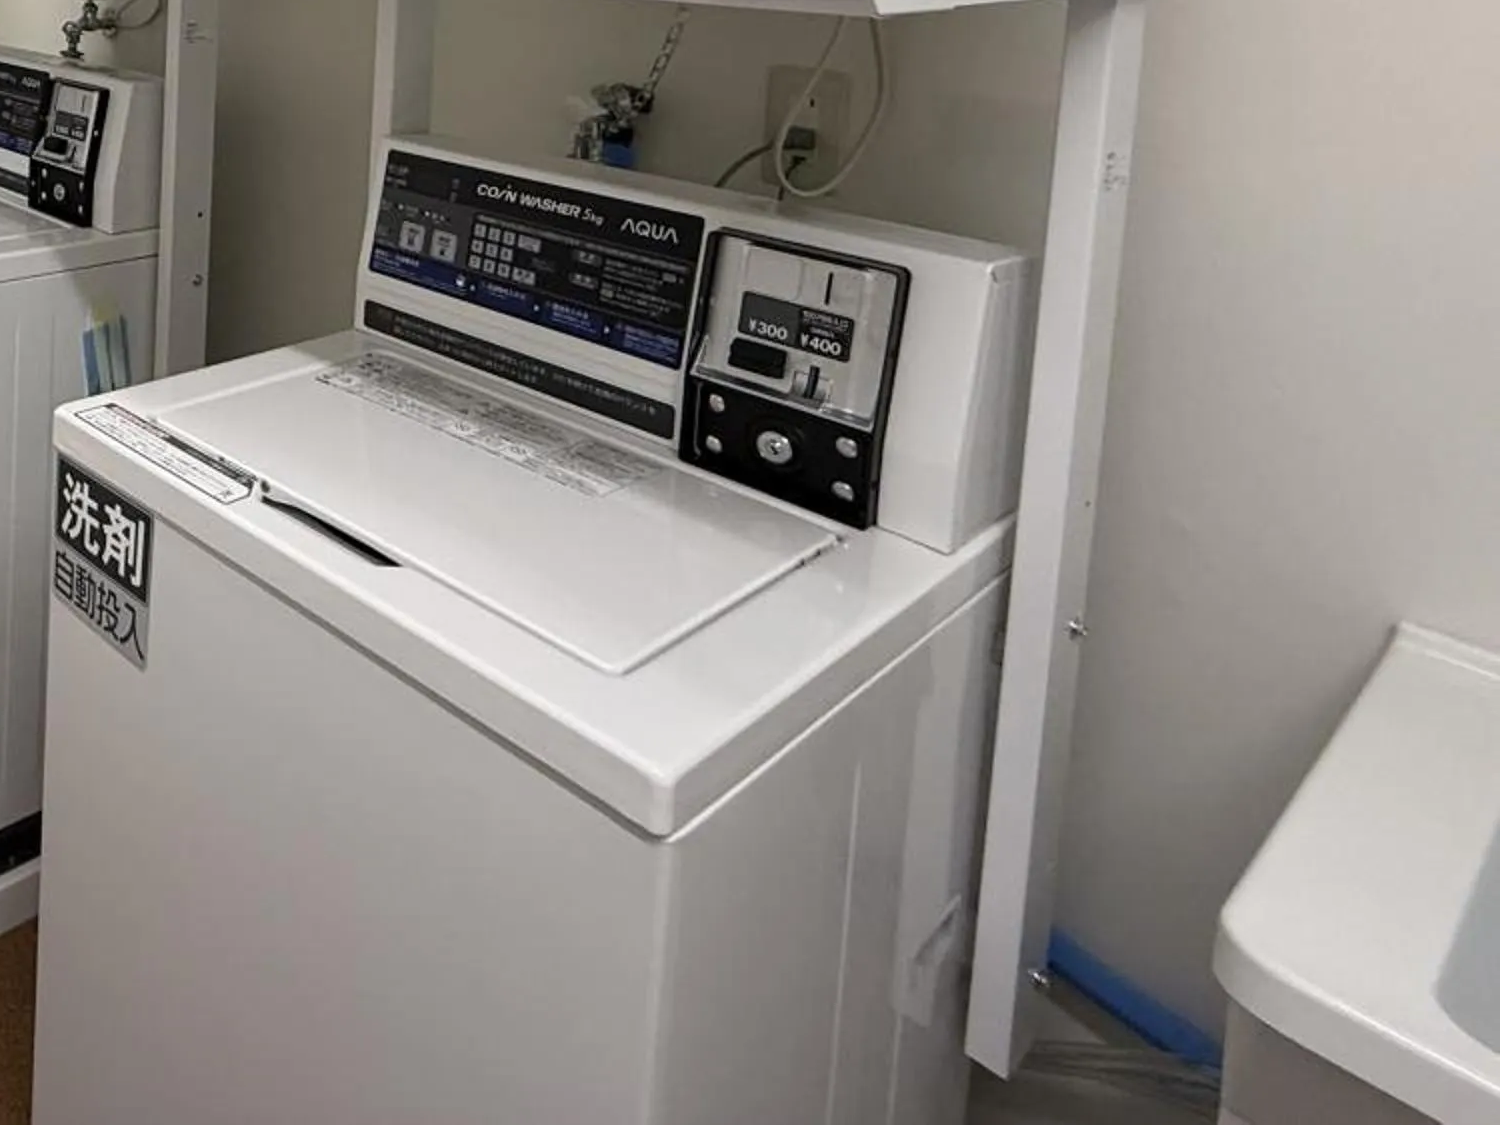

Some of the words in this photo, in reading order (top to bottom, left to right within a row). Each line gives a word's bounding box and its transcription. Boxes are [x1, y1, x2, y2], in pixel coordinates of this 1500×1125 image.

[519, 192, 581, 218] WASHER
[620, 217, 680, 245] AQUA
[60, 471, 146, 589] 洗剤
[53, 551, 145, 662] 自動投入
